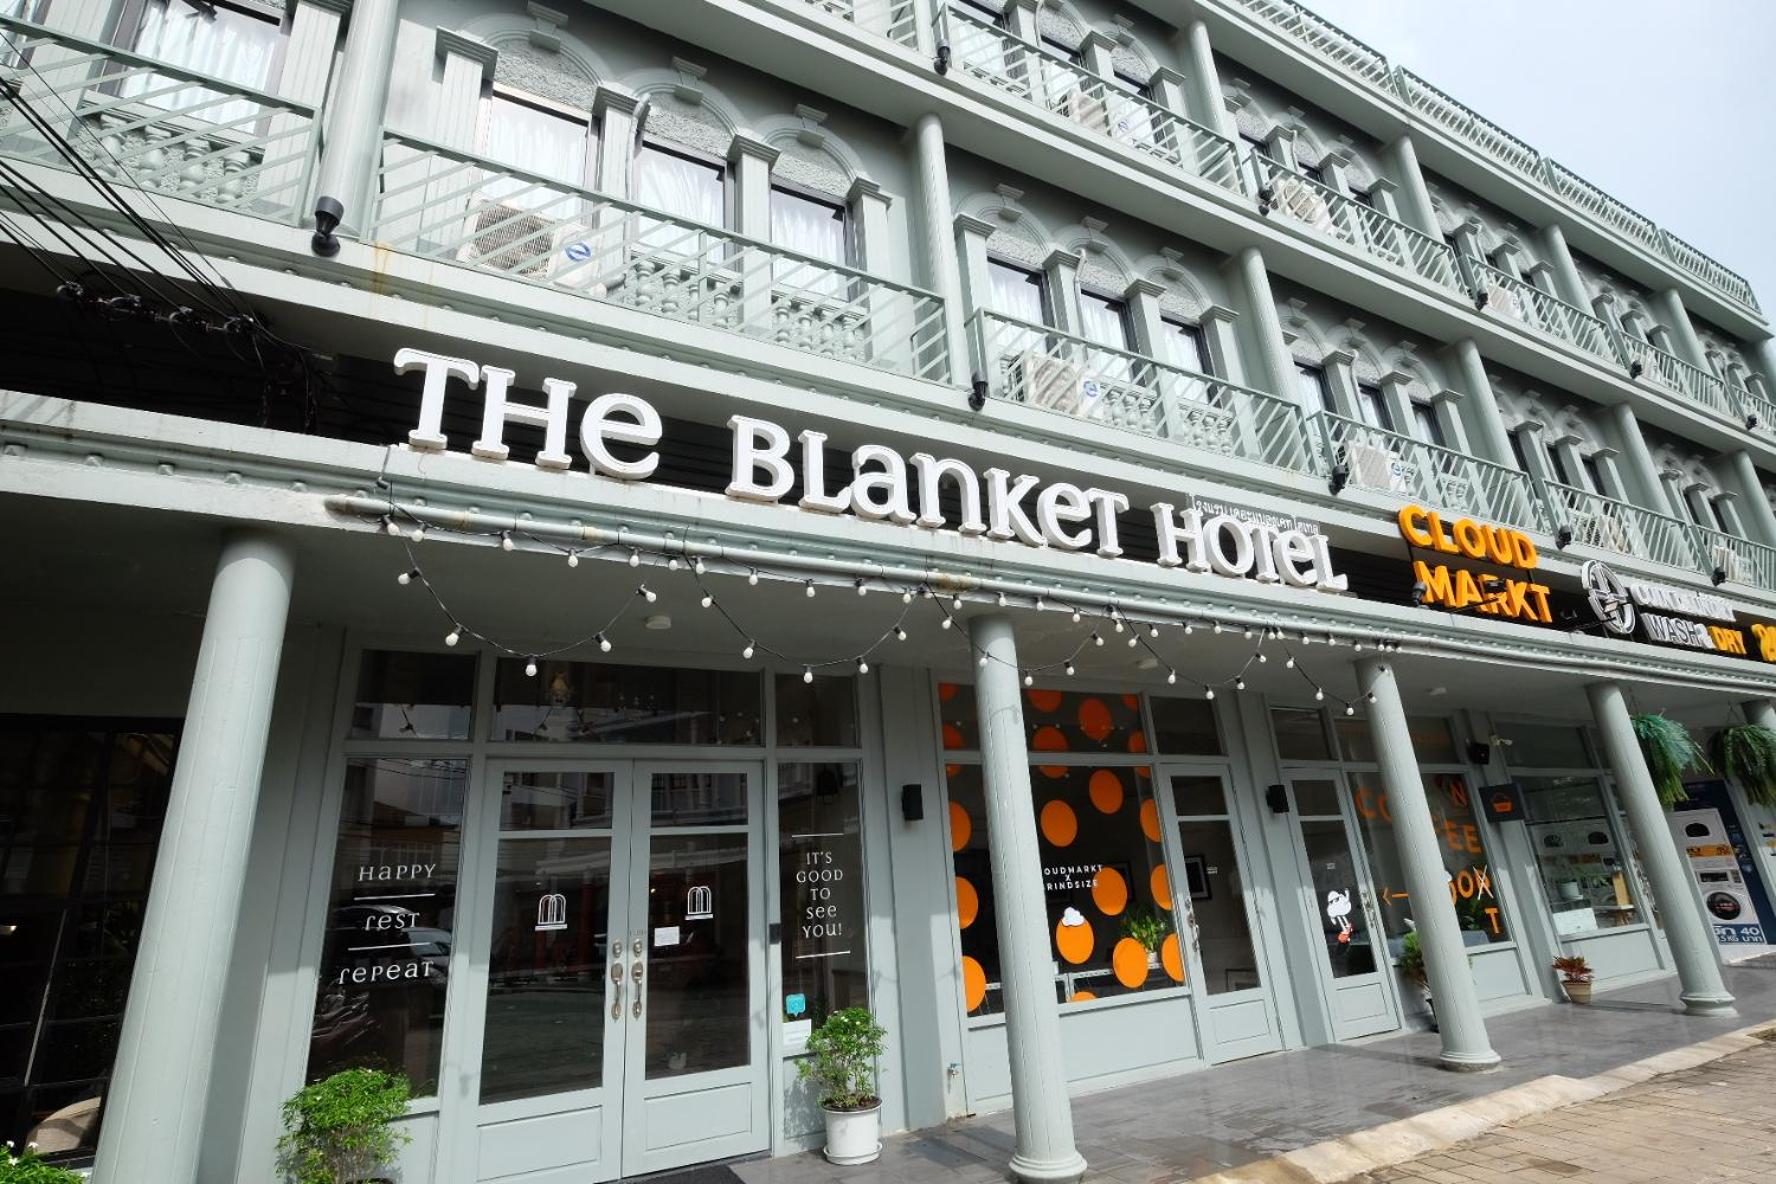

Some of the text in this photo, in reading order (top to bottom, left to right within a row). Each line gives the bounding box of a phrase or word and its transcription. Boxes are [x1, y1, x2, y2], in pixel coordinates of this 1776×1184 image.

[1399, 504, 1537, 569] CLOUD
[806, 851, 833, 865] IT'S
[795, 869, 844, 884] GOOD
[1043, 864, 1103, 875] OUDMARKT
[1046, 879, 1098, 891] RINDSIZE
[810, 887, 832, 901] TO
[1740, 927, 1760, 936] 40
